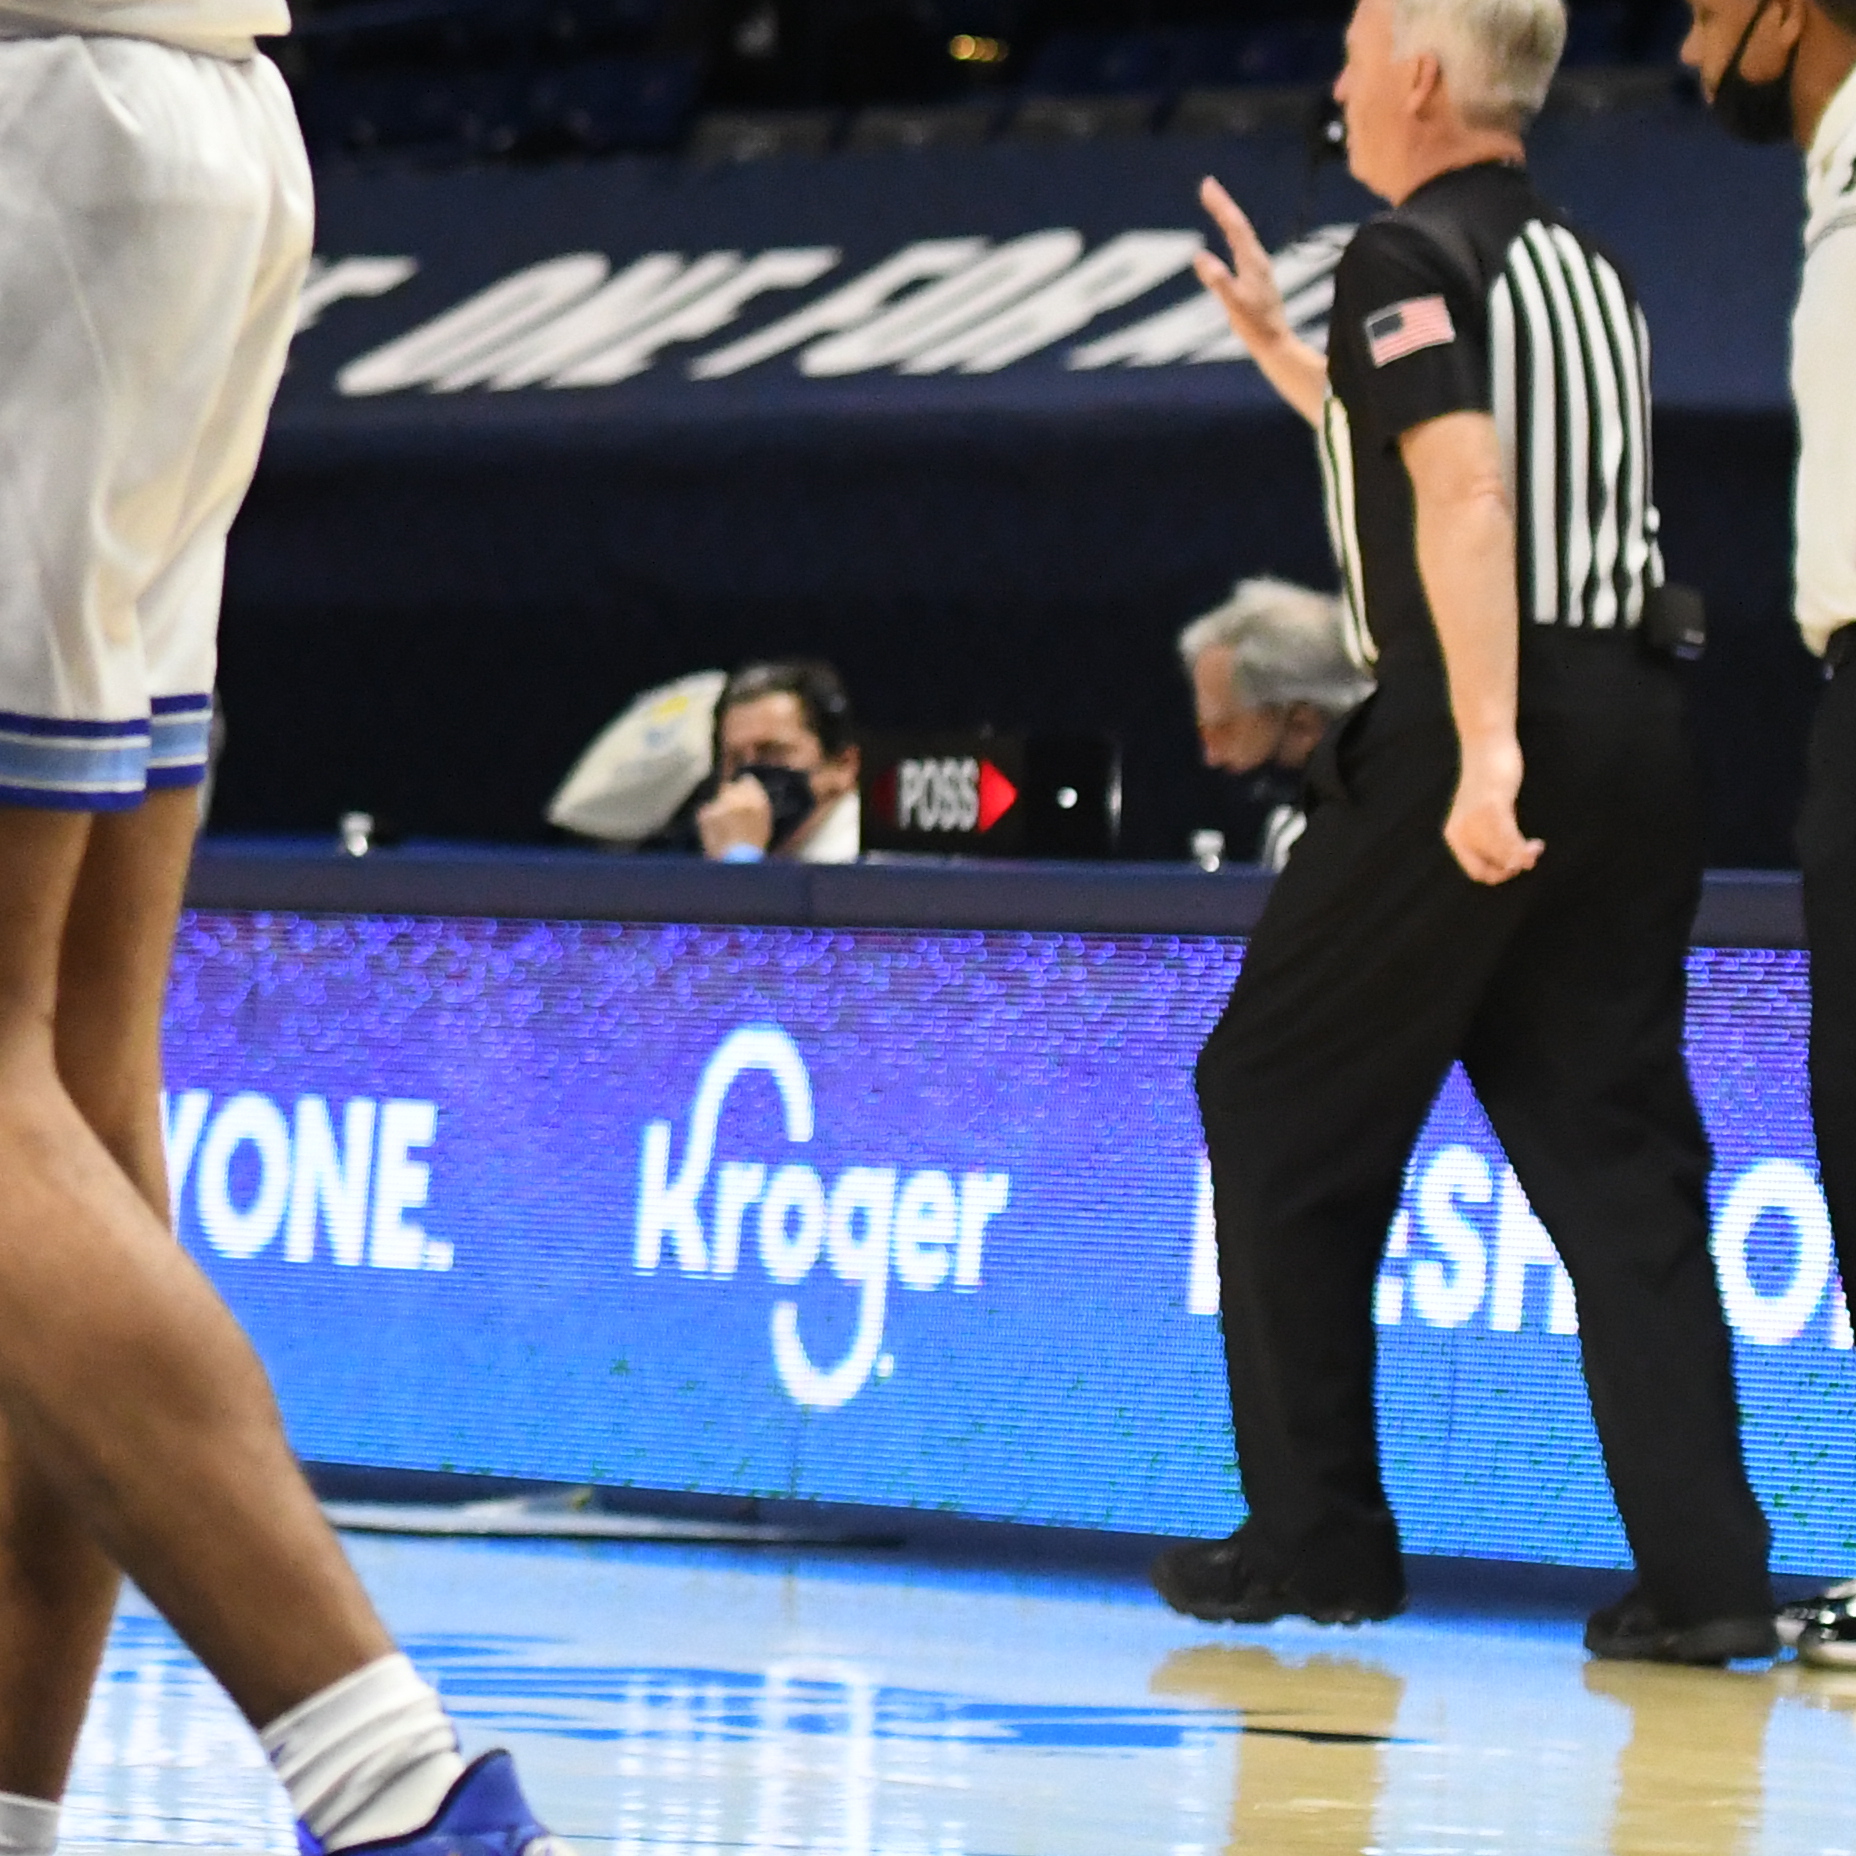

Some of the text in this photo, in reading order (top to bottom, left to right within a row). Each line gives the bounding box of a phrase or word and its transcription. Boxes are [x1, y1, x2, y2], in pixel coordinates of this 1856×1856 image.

[688, 227, 1205, 379] FOR
[897, 756, 980, 832] POSS
[161, 1087, 455, 1272] YONE.
[632, 1026, 1009, 1411] Kroger
